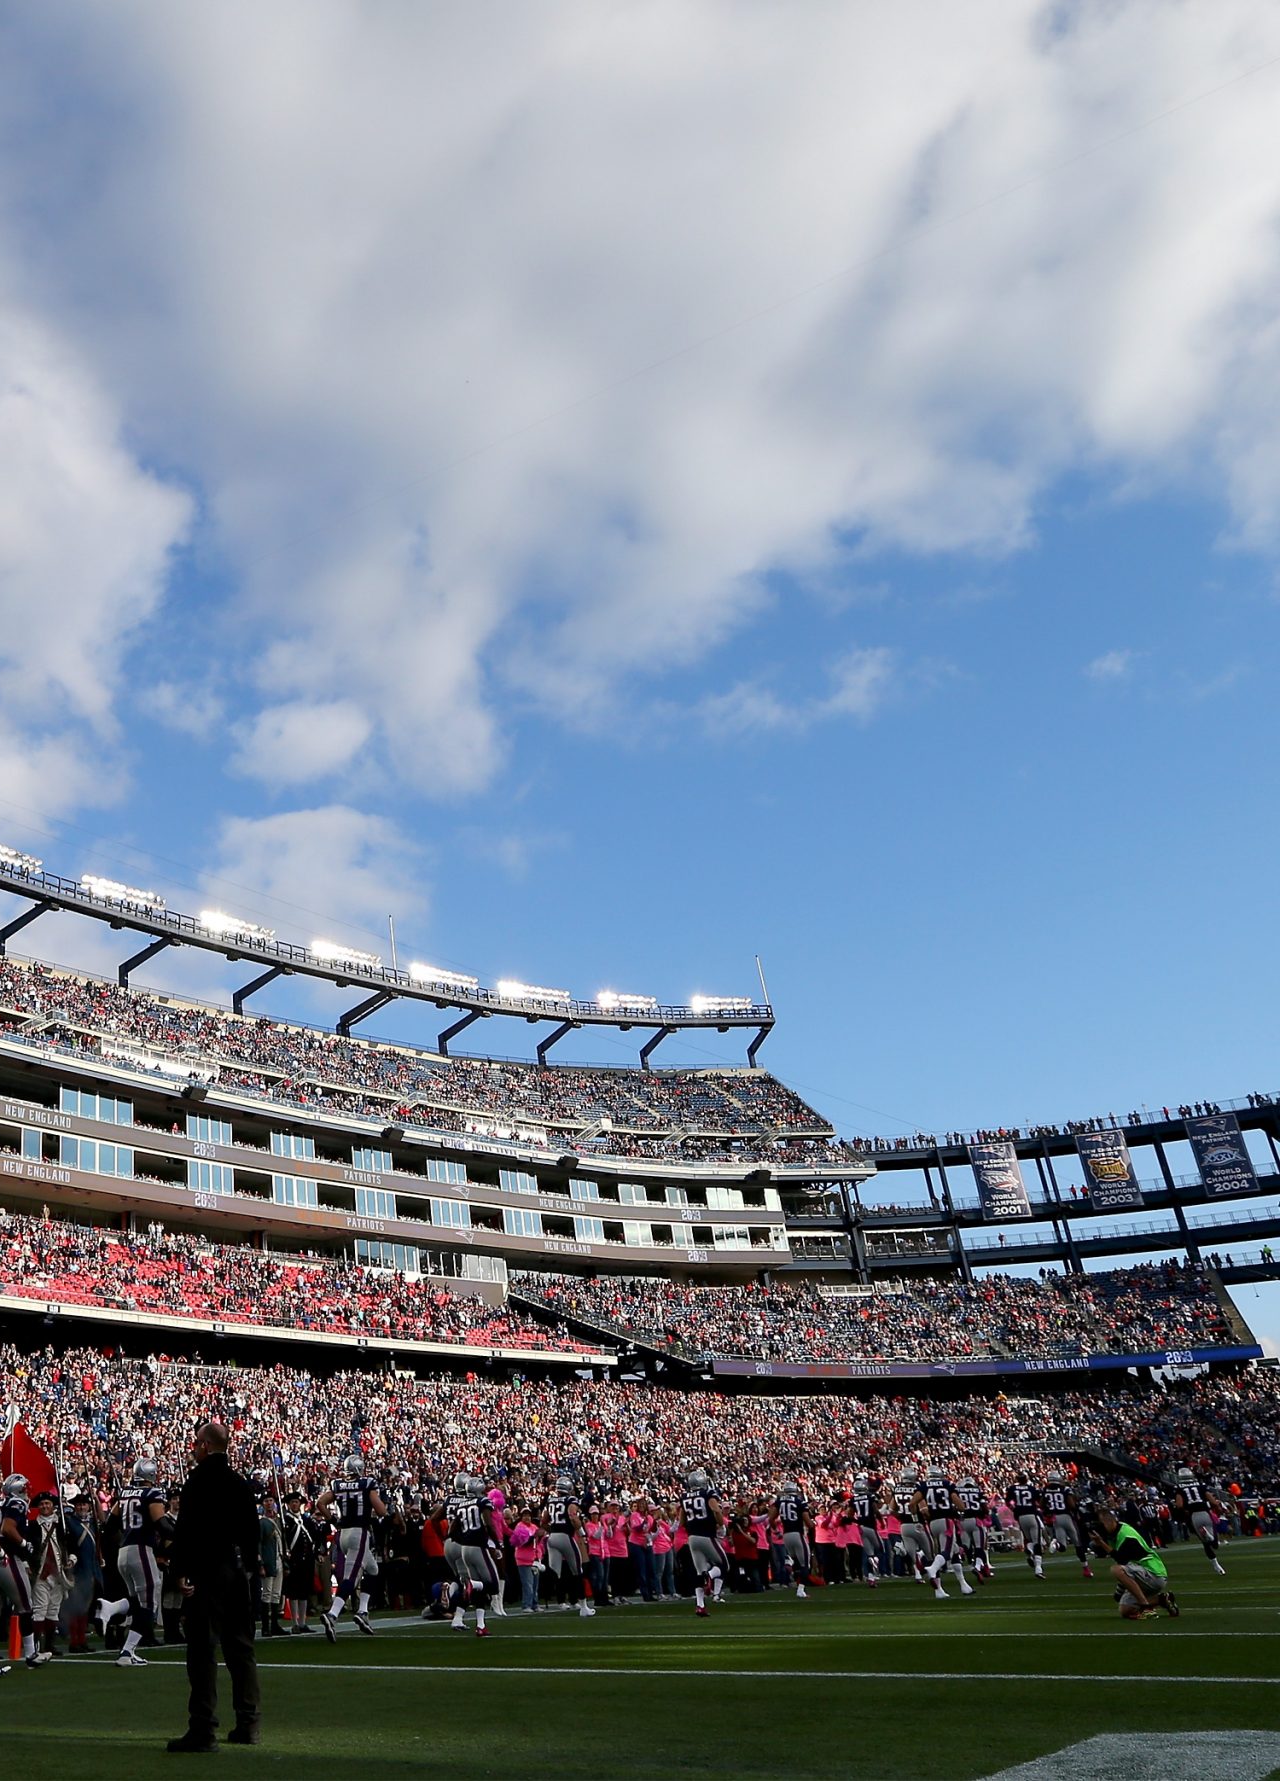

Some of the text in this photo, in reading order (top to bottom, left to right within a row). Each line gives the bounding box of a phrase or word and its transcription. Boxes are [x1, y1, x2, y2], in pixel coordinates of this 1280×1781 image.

[5, 1103, 72, 1129] NEW ENGLAND
[3, 1160, 71, 1183] NEW ENGLAND
[343, 1169, 382, 1185] PATRIOTS
[1206, 1172, 1253, 1184] CHAMPIONS
[1212, 1167, 1241, 1176] WORLD
[1093, 1187, 1138, 1197] CHAMPIONS
[1099, 1181, 1127, 1190] WORLD
[1213, 1179, 1250, 1192] 2004
[539, 1197, 586, 1212] NEW ENGLAND
[984, 1199, 1027, 1207] CHAMPIONS
[1100, 1193, 1134, 1205] 2003
[992, 1205, 1022, 1216] 2001
[346, 1217, 385, 1232] PATRIOTS
[544, 1240, 592, 1254] NEW ENGLAND
[851, 1365, 891, 1375] PATRIOTS
[1024, 1358, 1090, 1371] NEW ENGLAND
[335, 1490, 364, 1517] 77
[926, 1488, 951, 1510] 43
[1013, 1490, 1033, 1507] 12
[1044, 1492, 1066, 1511] 38
[1183, 1486, 1203, 1505] 11
[682, 1497, 708, 1521] 59
[779, 1501, 799, 1522] 46
[853, 1499, 869, 1518] 17
[894, 1494, 913, 1515] 52
[119, 1498, 144, 1530] 76
[456, 1505, 482, 1533] 30
[548, 1502, 567, 1525] 92
